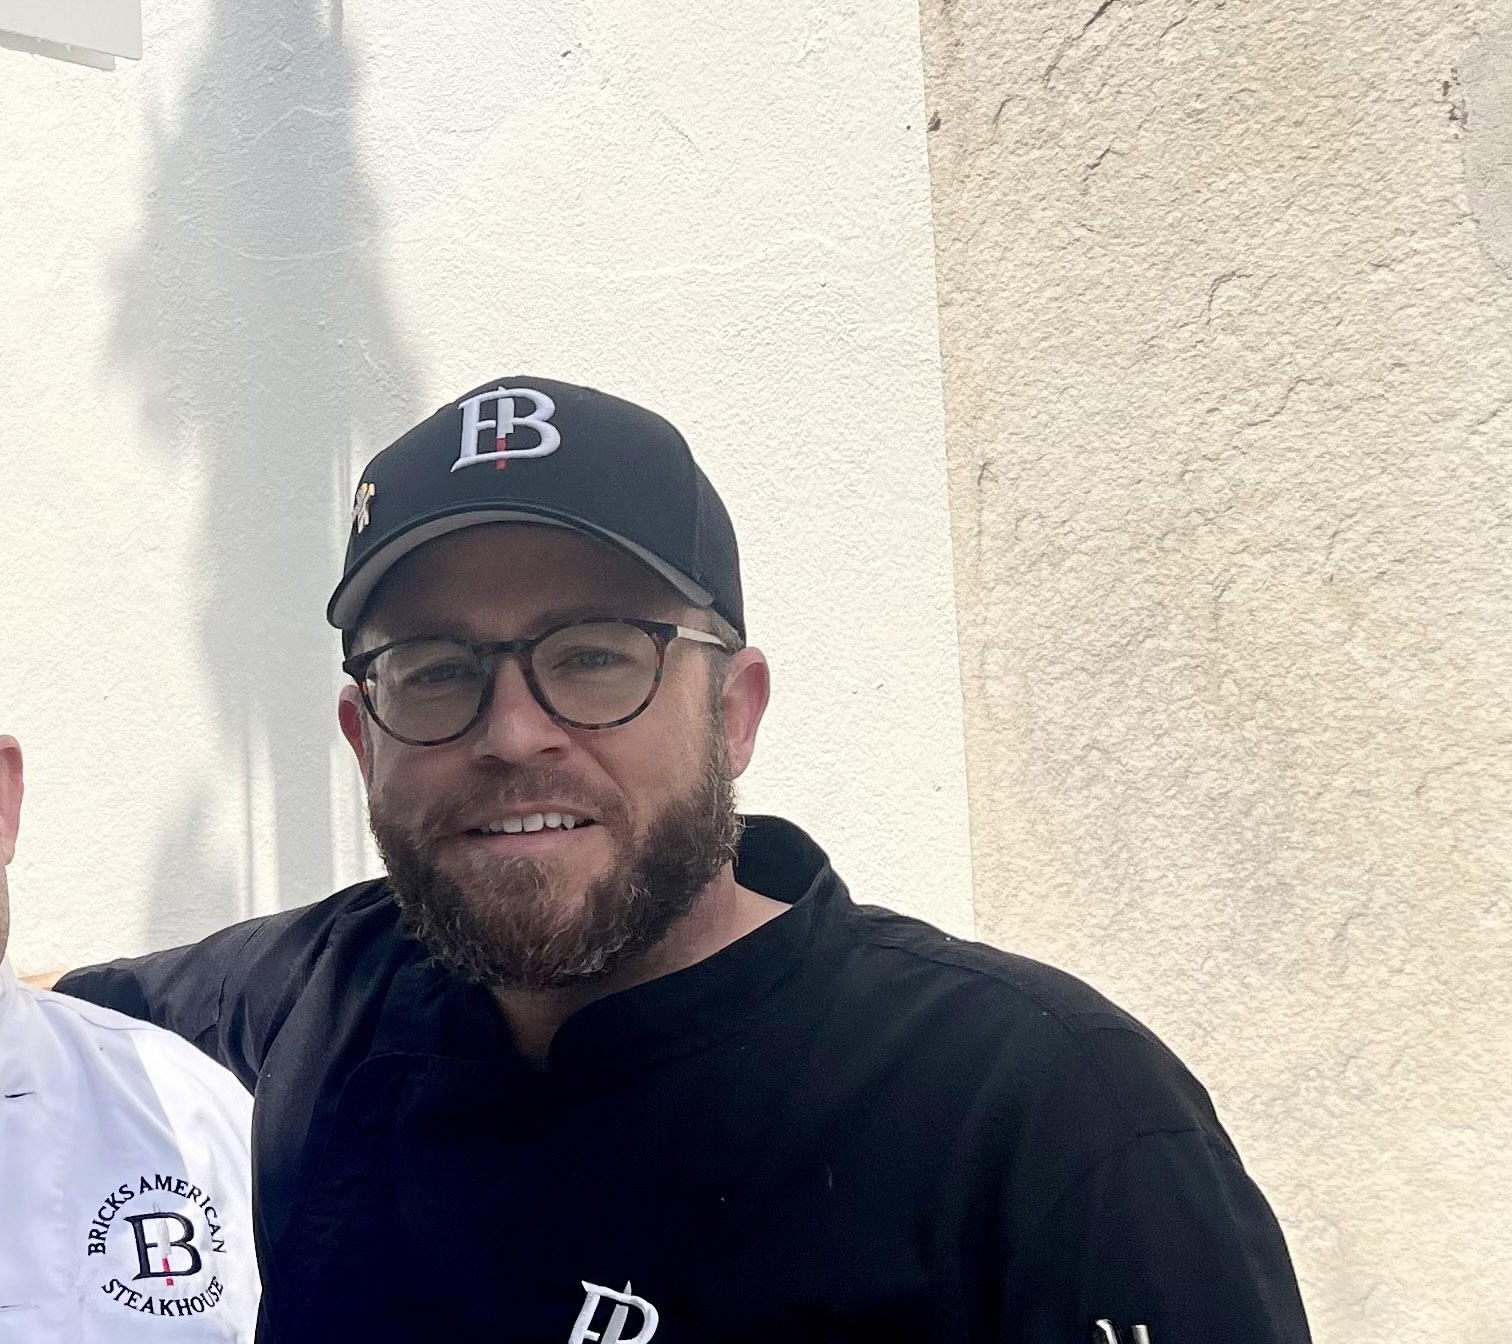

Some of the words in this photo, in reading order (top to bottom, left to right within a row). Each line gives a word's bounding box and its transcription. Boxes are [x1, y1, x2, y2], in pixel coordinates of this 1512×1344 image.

[87, 1183, 135, 1256] BRICKS
[139, 1173, 227, 1254] AMERICAN
[101, 1275, 224, 1317] STEAKHOUSE
